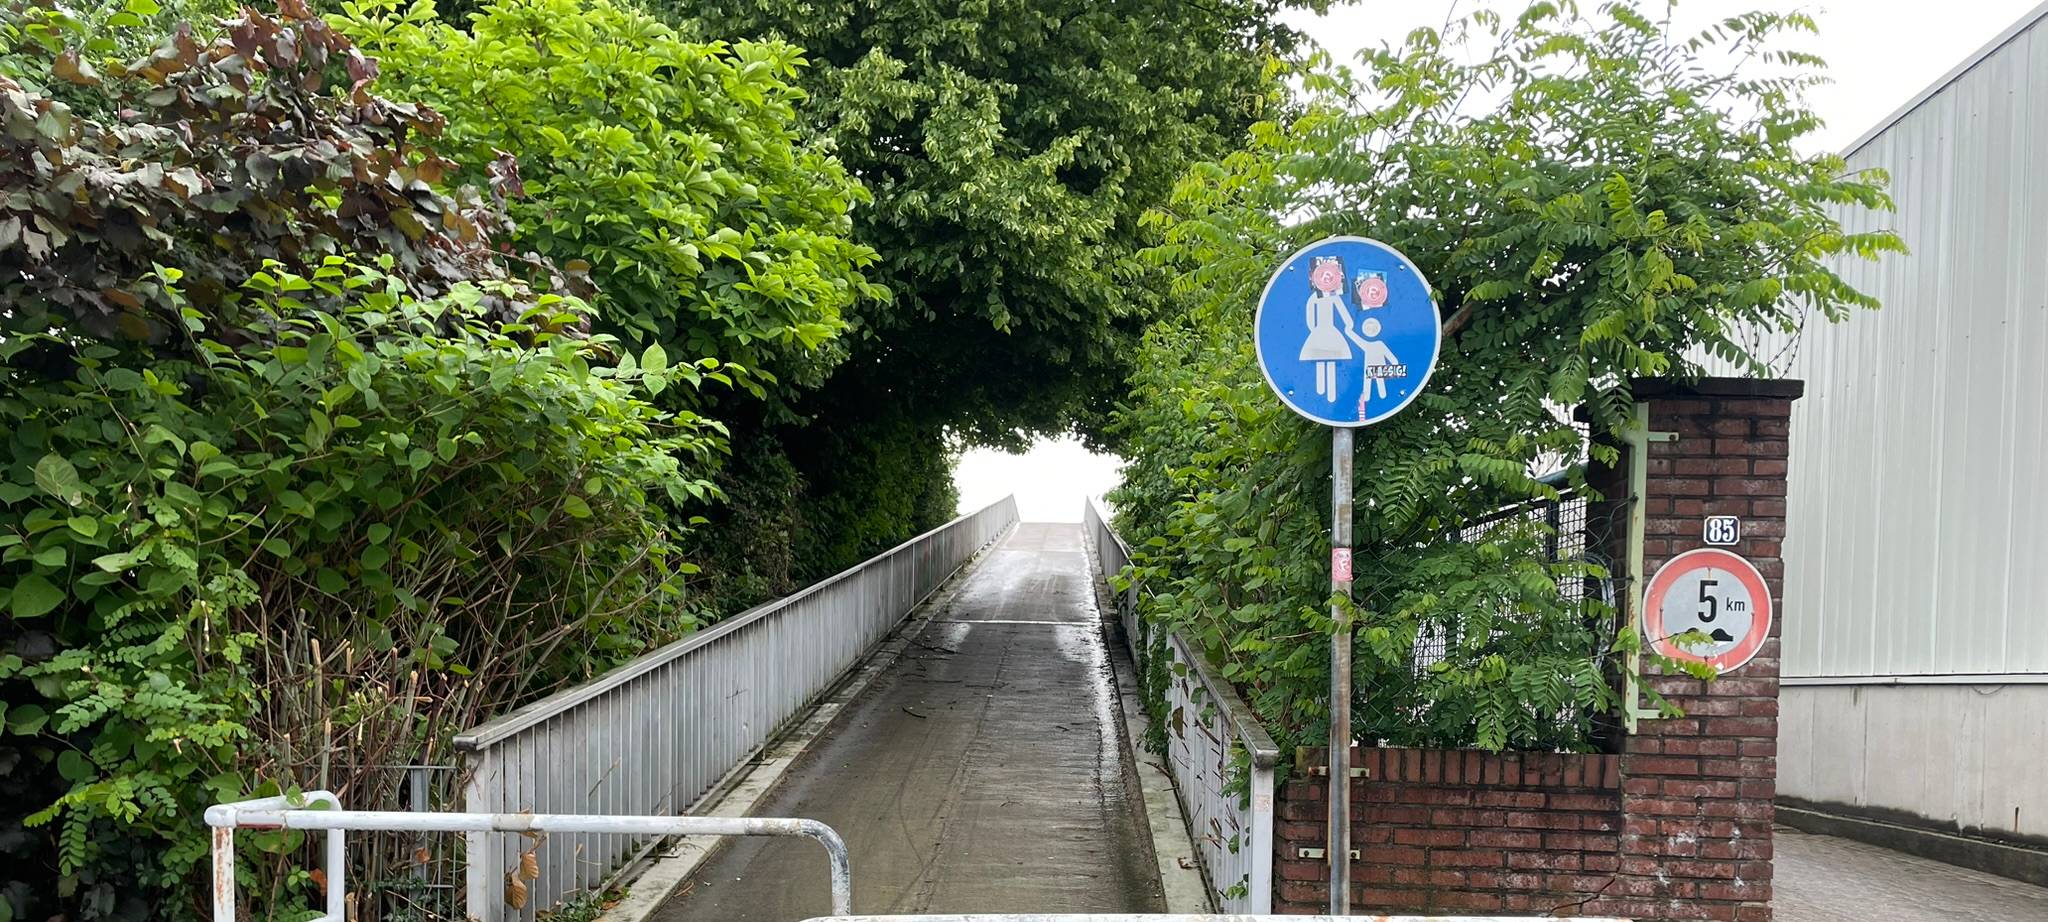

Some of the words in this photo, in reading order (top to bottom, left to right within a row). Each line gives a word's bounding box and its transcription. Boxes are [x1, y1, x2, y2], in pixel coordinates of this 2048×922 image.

[1367, 365, 1407, 377] KLASSIG!
[1709, 518, 1735, 541] 85
[1697, 580, 1718, 622] 5
[1726, 597, 1745, 611] km
